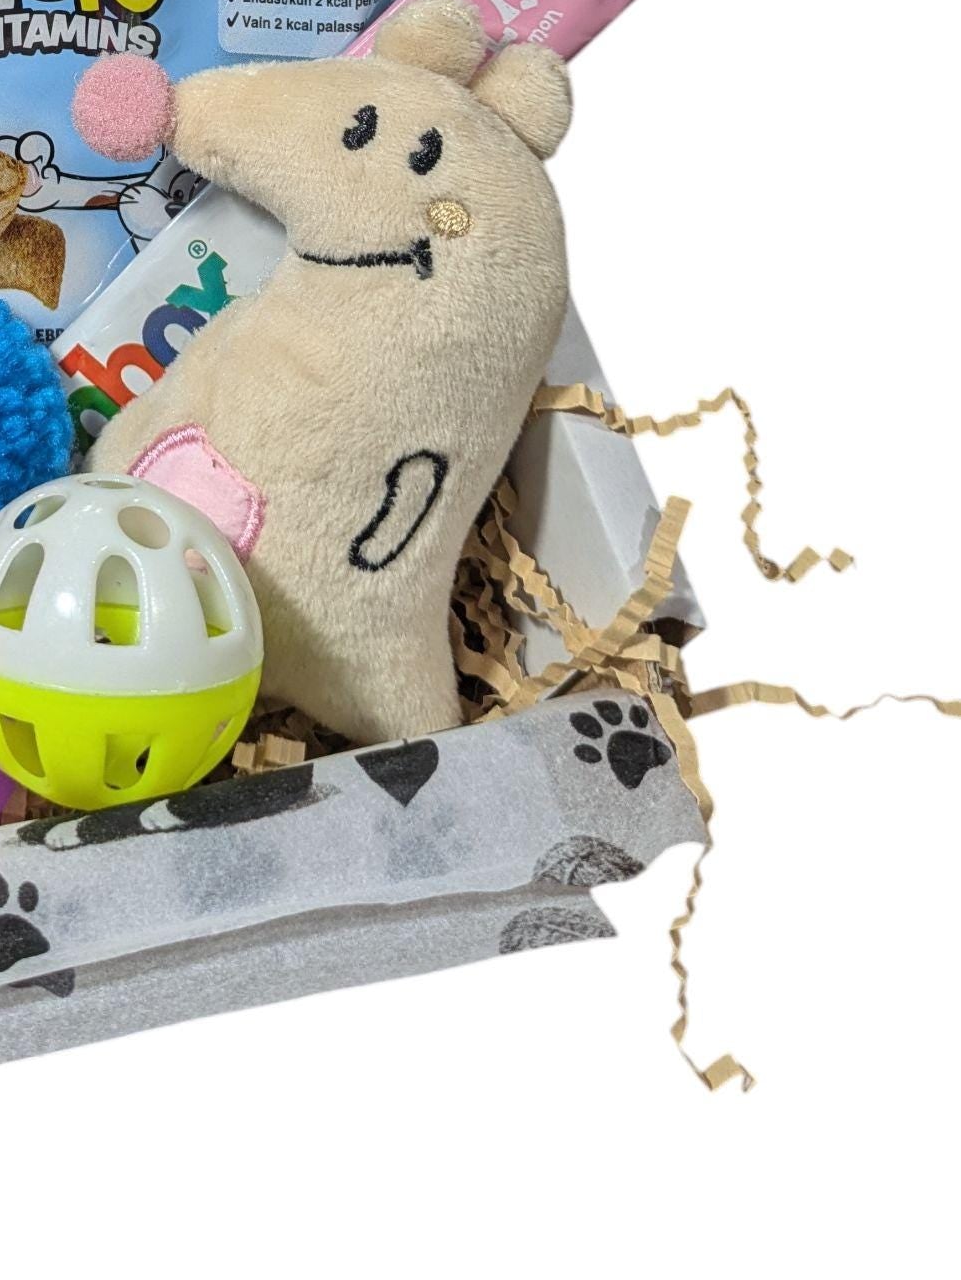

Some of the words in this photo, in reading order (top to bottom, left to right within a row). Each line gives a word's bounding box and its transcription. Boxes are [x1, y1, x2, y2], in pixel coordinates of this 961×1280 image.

[242, 15, 271, 29] Vain
[274, 17, 283, 29] 2
[286, 18, 313, 31] kcal
